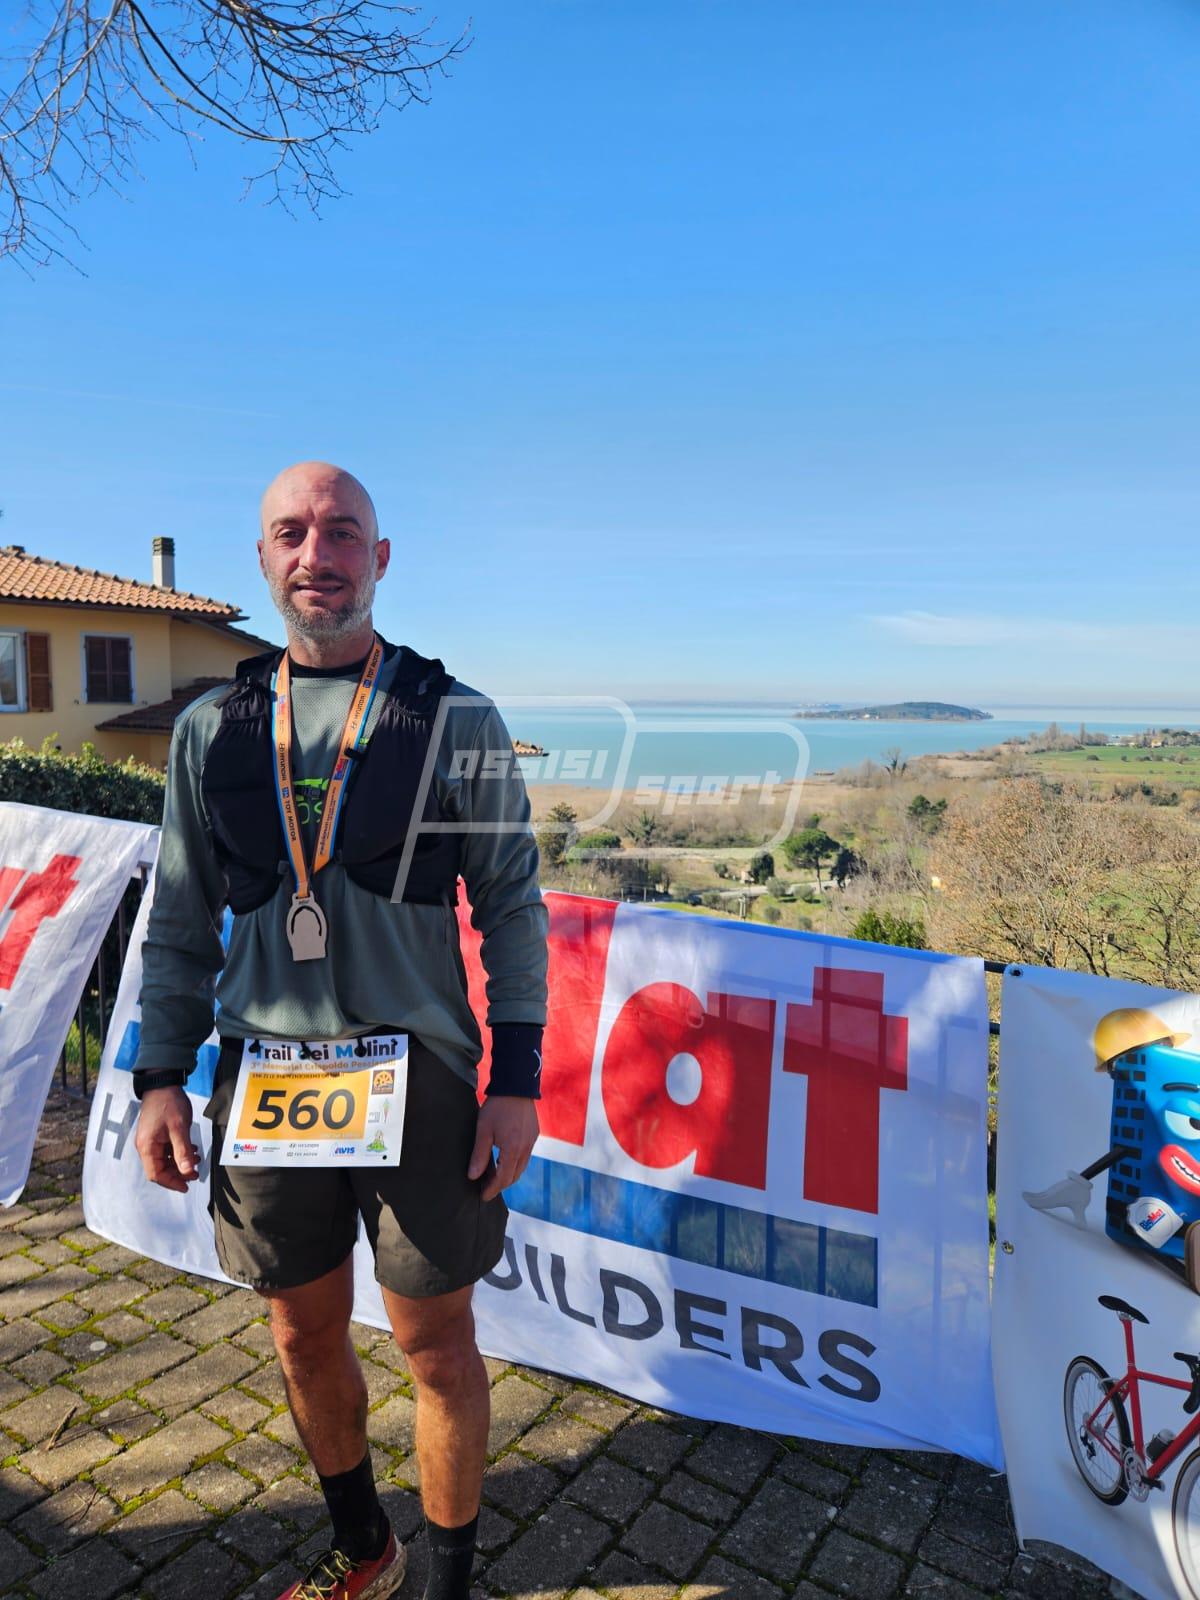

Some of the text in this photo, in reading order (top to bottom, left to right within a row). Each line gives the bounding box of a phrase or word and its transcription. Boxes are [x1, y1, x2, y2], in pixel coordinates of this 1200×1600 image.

[335, 1039, 397, 1060] Mlini
[252, 1088, 355, 1130] 560
[483, 1237, 881, 1402] UILDERS
